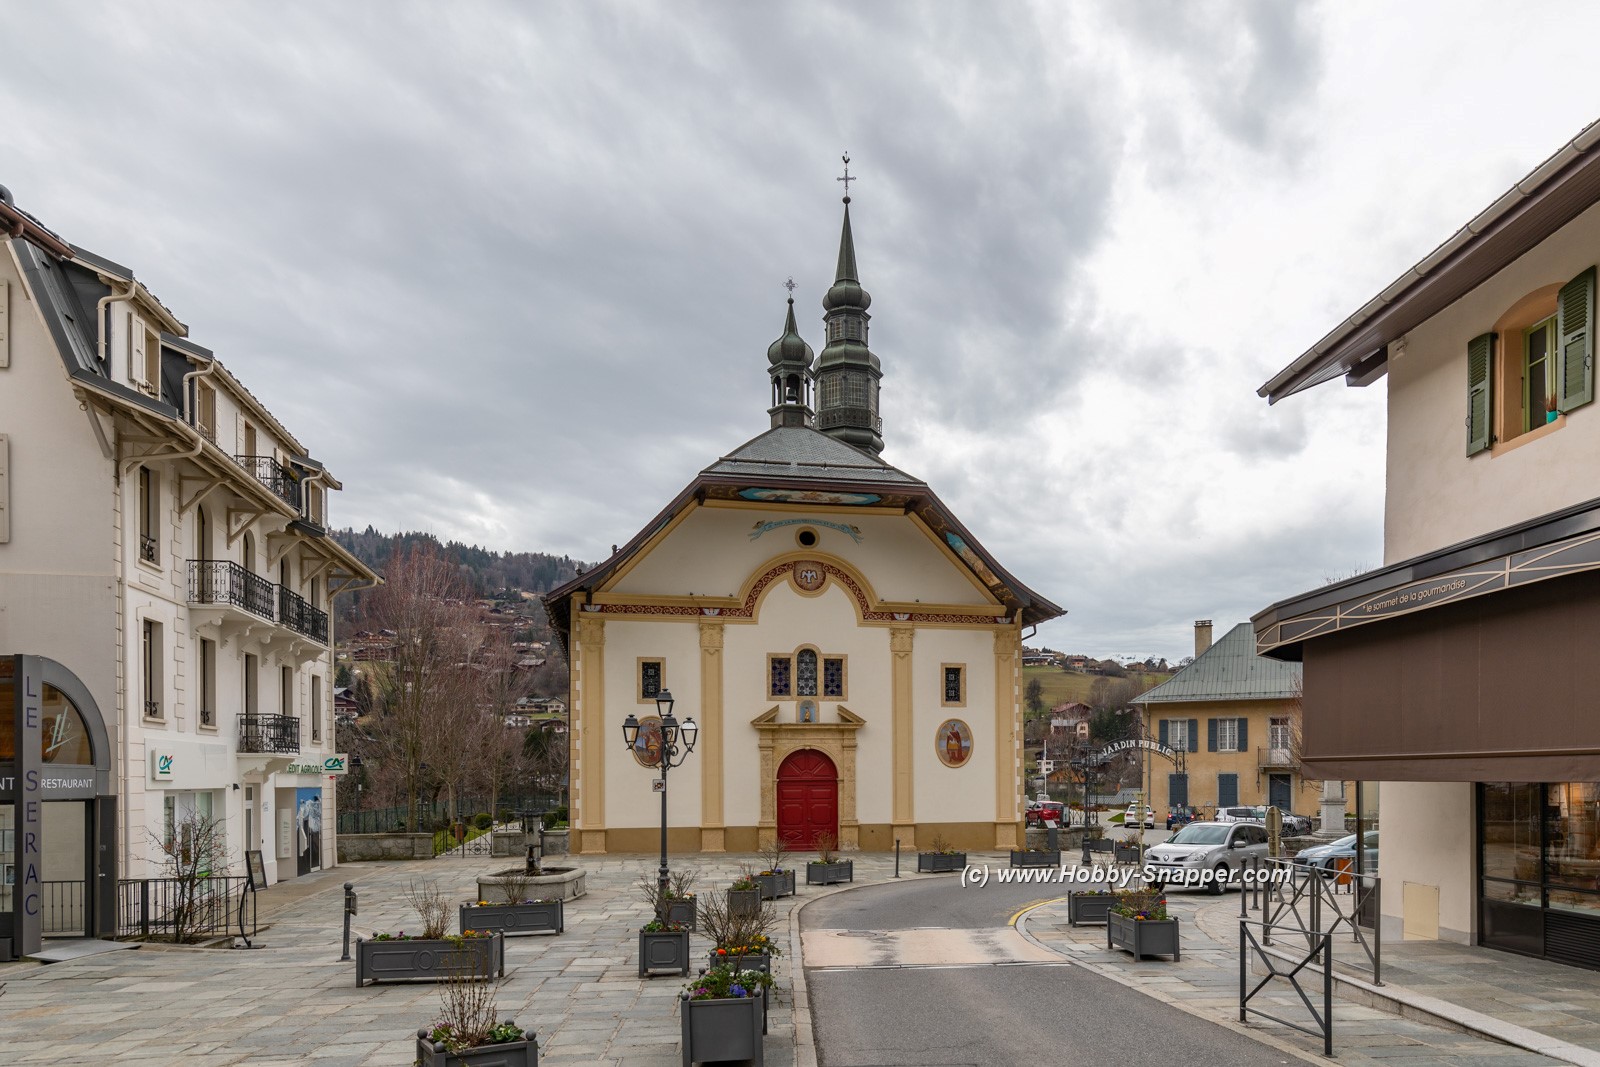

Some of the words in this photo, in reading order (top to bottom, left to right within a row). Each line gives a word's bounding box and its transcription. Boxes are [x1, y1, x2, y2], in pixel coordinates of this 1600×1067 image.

[1373, 596, 1398, 611] sommet
[1400, 594, 1408, 603] de
[1409, 592, 1417, 601] la
[1418, 579, 1466, 600] gourmandise
[26, 675, 38, 728] LE
[1102, 740, 1136, 756] JARDIN
[1138, 740, 1172, 756] PUBLIC
[301, 765, 322, 774] AGRICOLE
[41, 779, 93, 789] RESTAURANT
[25, 769, 38, 916] SERAC
